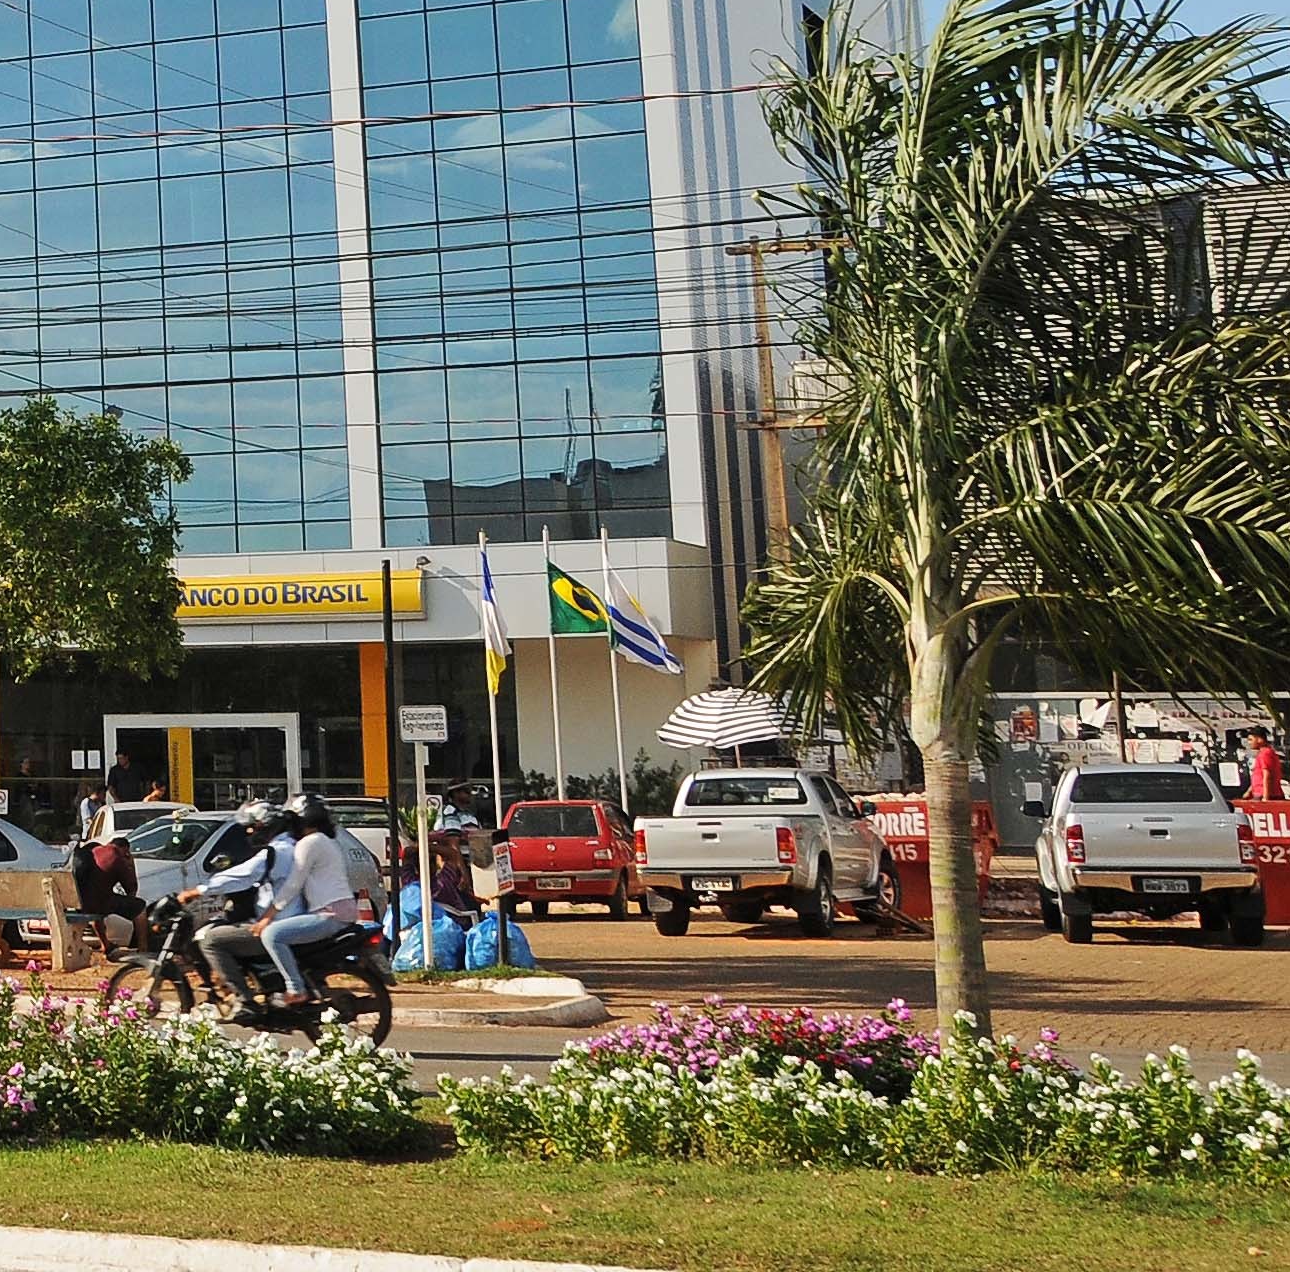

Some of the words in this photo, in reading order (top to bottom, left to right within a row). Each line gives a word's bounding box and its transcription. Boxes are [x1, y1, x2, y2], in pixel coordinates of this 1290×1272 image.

[179, 587, 239, 606] ANCO
[244, 586, 277, 605] DO
[1247, 813, 1290, 837] ELL
